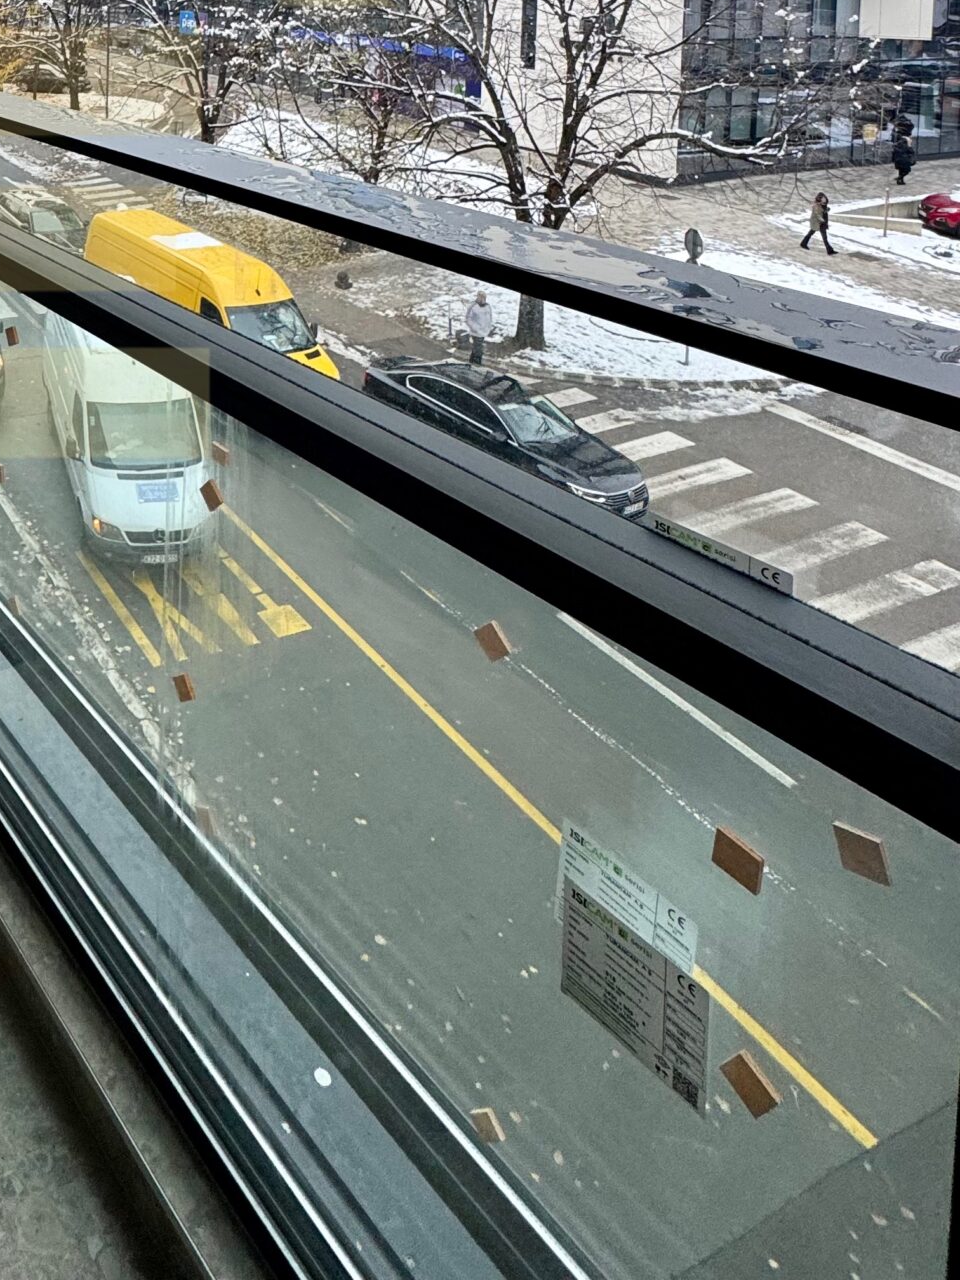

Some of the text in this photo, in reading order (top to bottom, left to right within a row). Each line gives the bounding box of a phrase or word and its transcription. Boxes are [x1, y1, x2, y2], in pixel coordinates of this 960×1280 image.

[760, 566, 781, 585] CE
[667, 908, 687, 930] CE
[677, 974, 697, 999] CE
